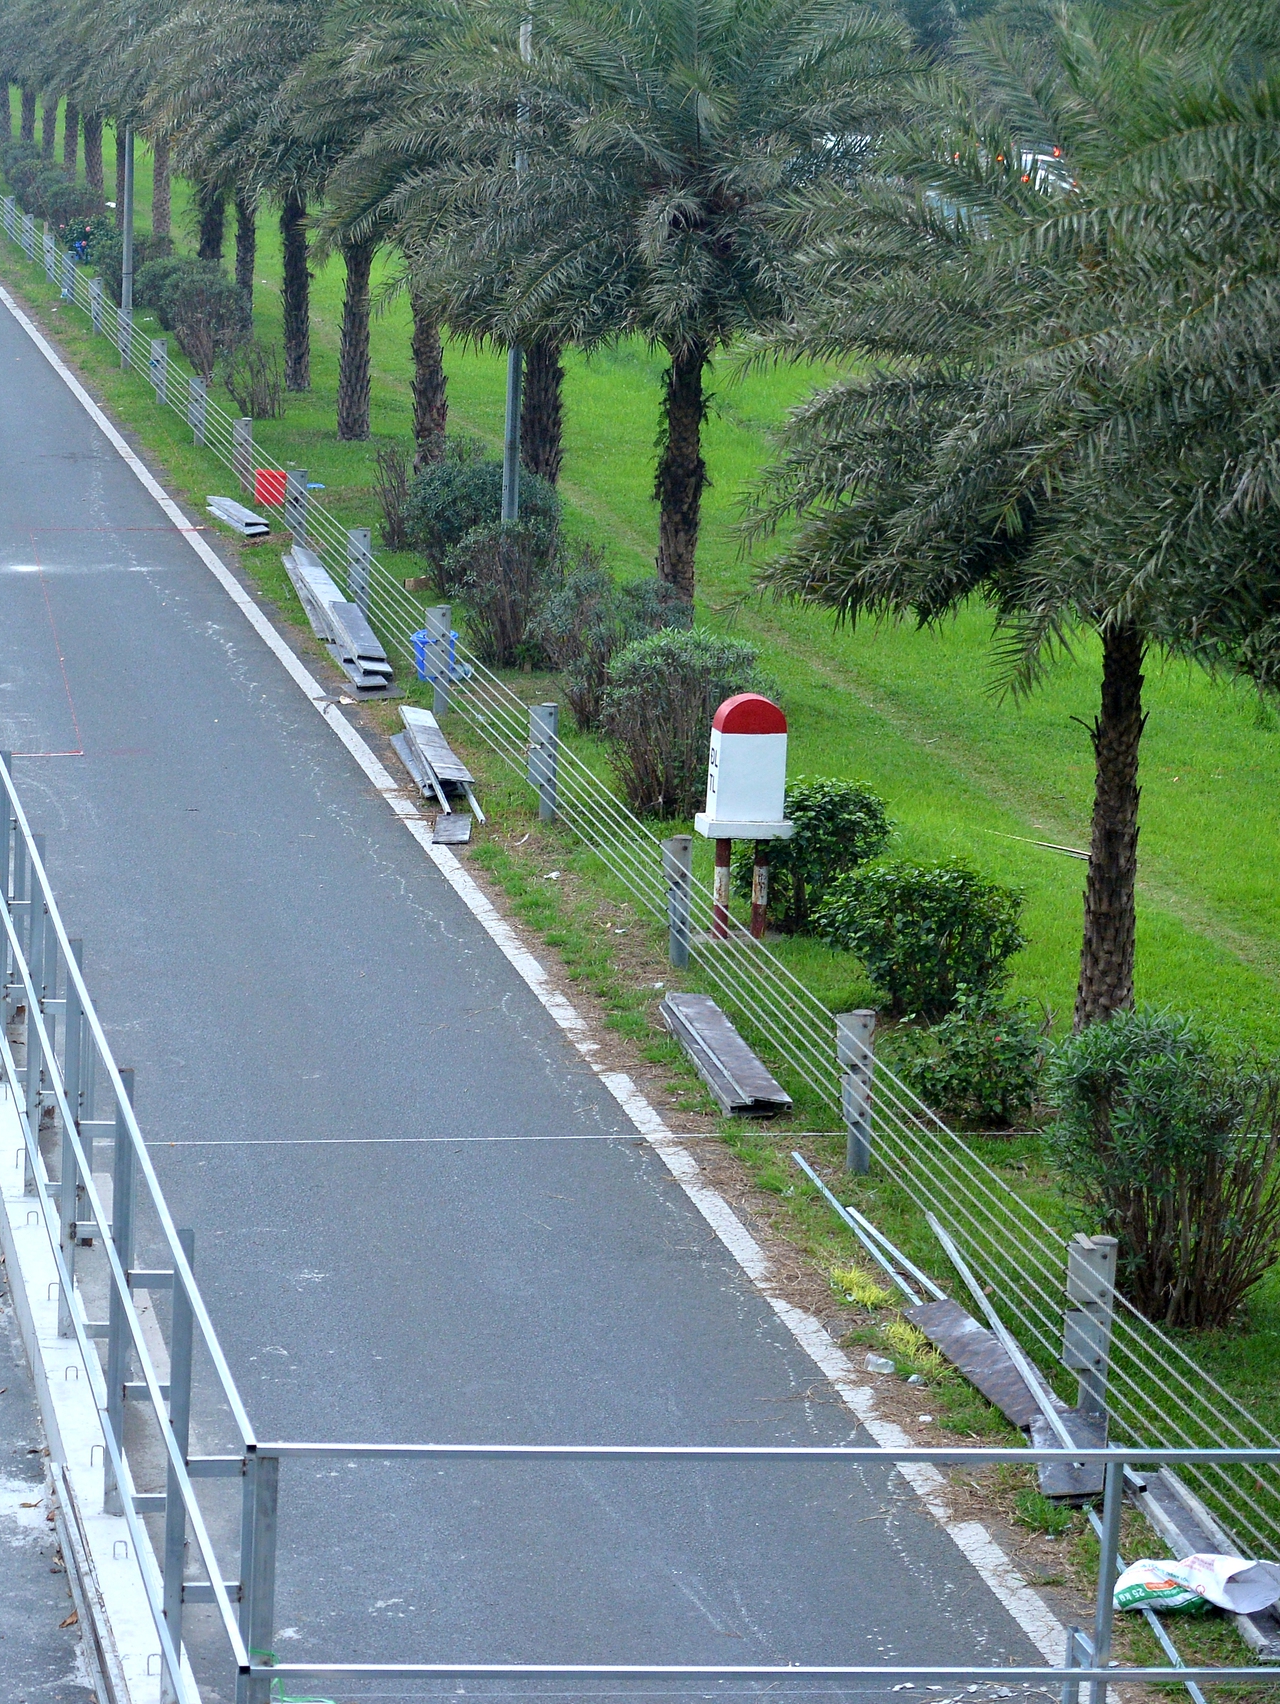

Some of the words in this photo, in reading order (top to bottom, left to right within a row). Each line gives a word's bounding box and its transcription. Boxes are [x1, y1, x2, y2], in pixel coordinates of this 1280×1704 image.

[709, 773, 716, 794] TL
[1118, 1592, 1132, 1603] kg
[1131, 1587, 1146, 1598] 25
